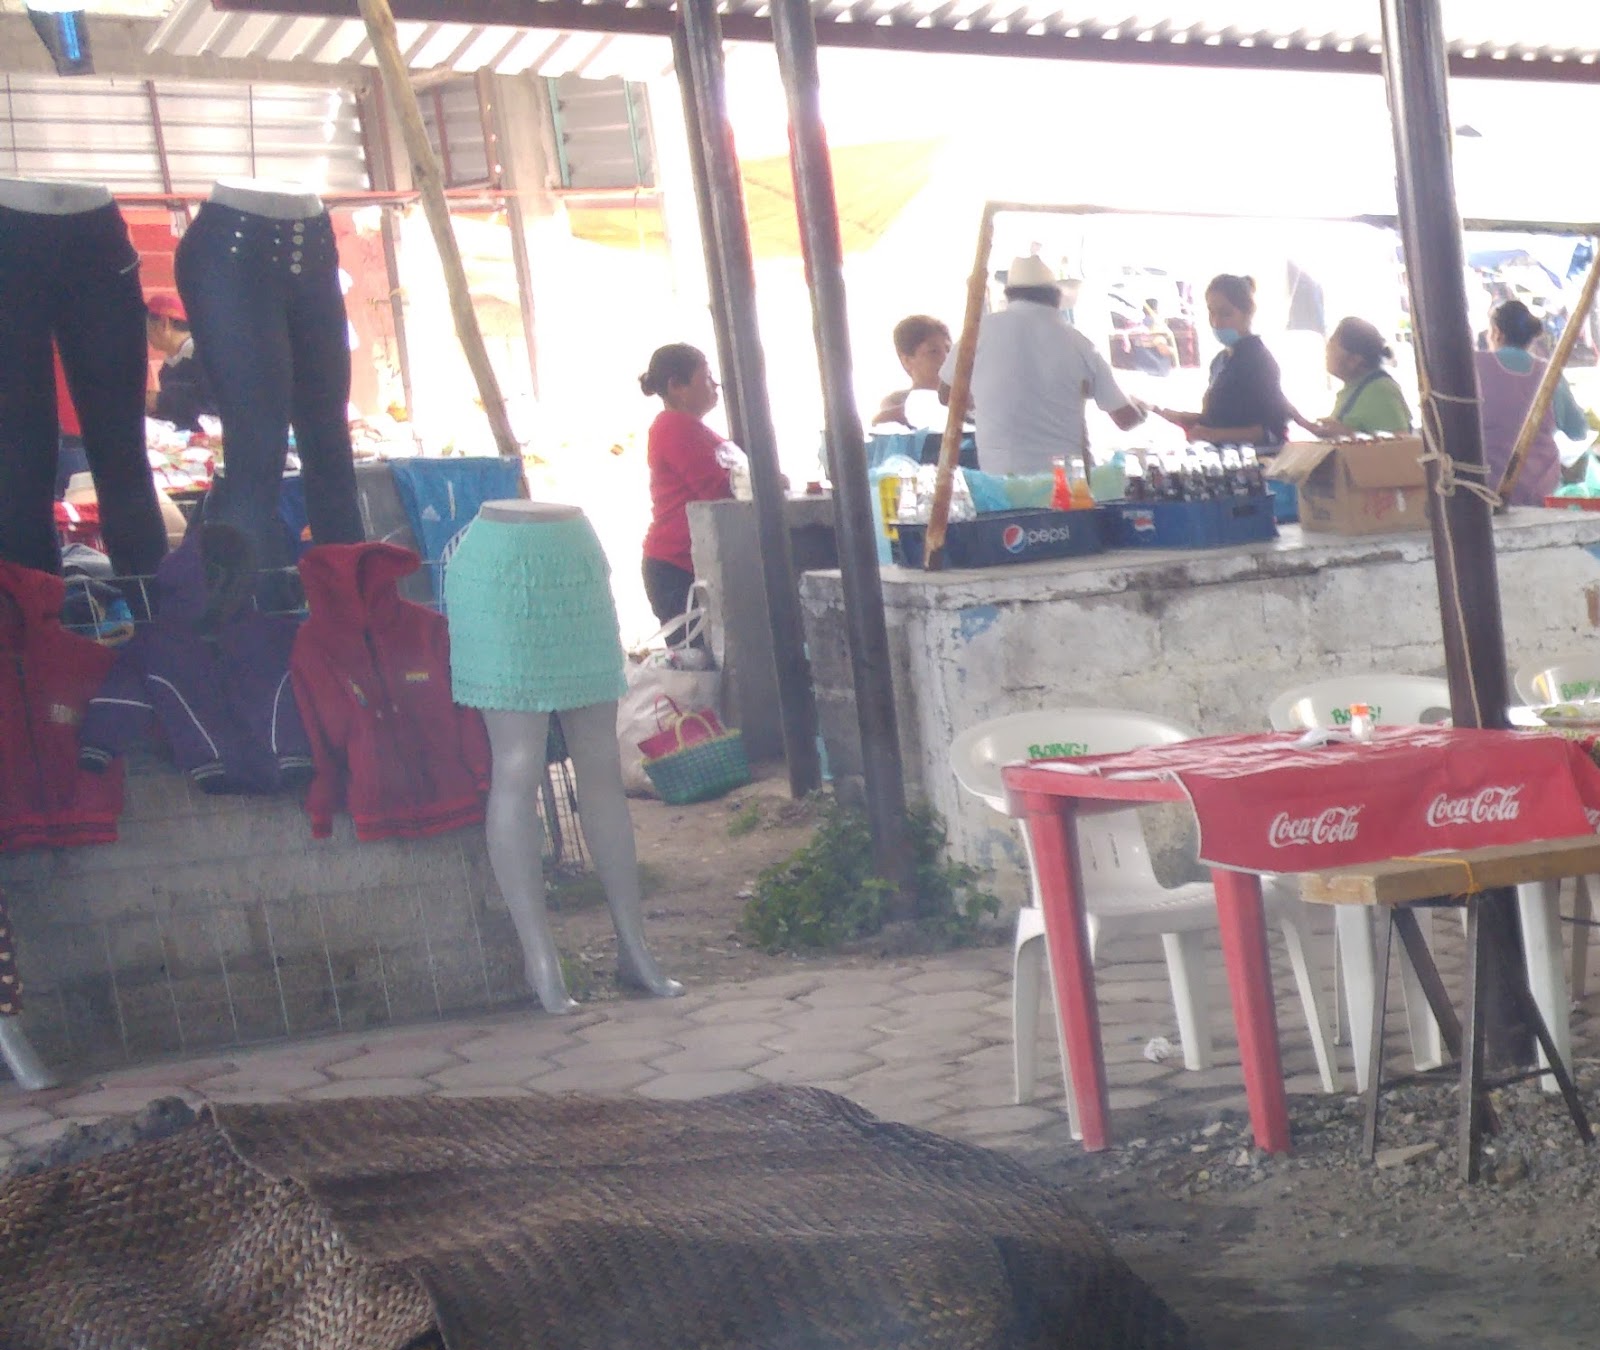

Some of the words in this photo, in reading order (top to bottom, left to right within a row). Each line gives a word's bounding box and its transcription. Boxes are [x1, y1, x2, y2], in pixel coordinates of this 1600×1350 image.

[1027, 524, 1070, 546] pepsi
[1268, 805, 1364, 849] Coca-Cola
[1426, 784, 1523, 828] Coca-Cola
